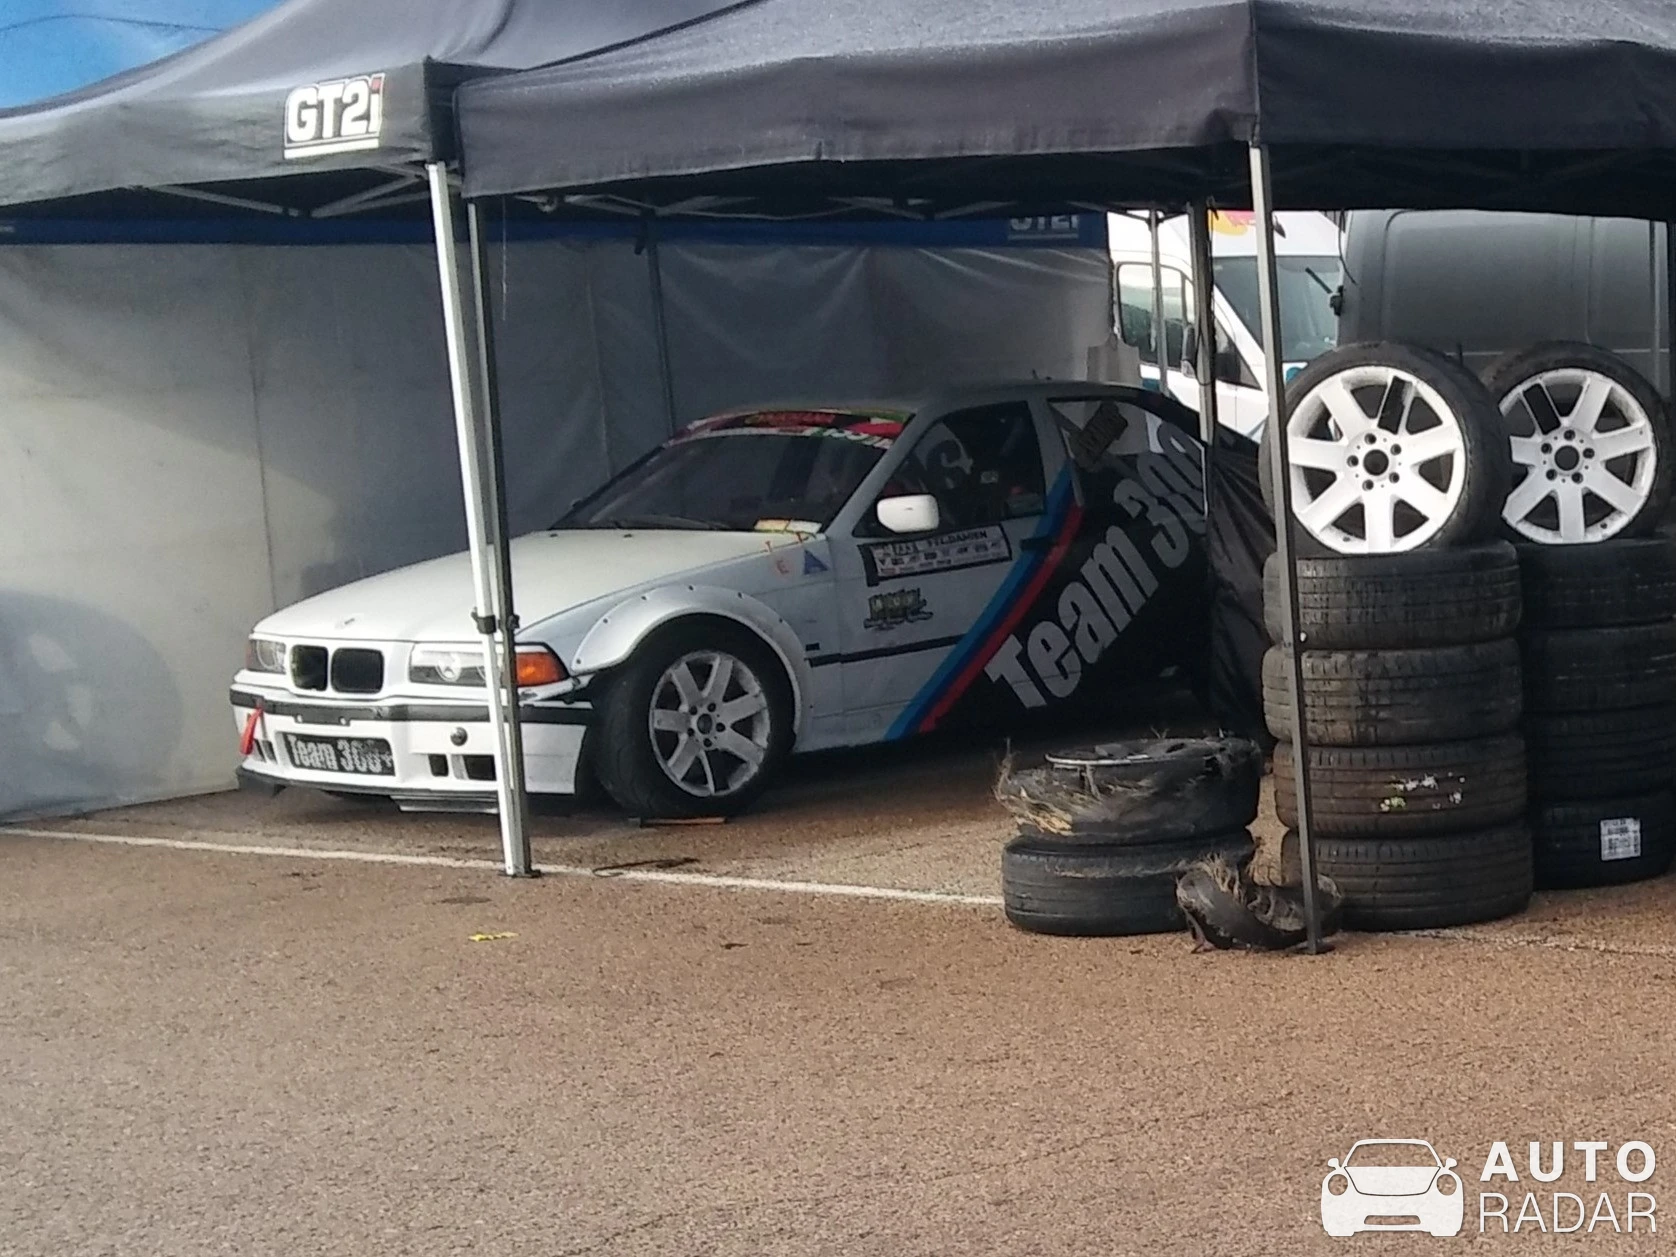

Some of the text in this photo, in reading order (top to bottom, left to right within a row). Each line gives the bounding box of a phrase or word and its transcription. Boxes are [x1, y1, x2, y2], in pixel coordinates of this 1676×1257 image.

[286, 75, 382, 143] GT2i
[984, 524, 1159, 708] Team
[286, 733, 339, 771] Team
